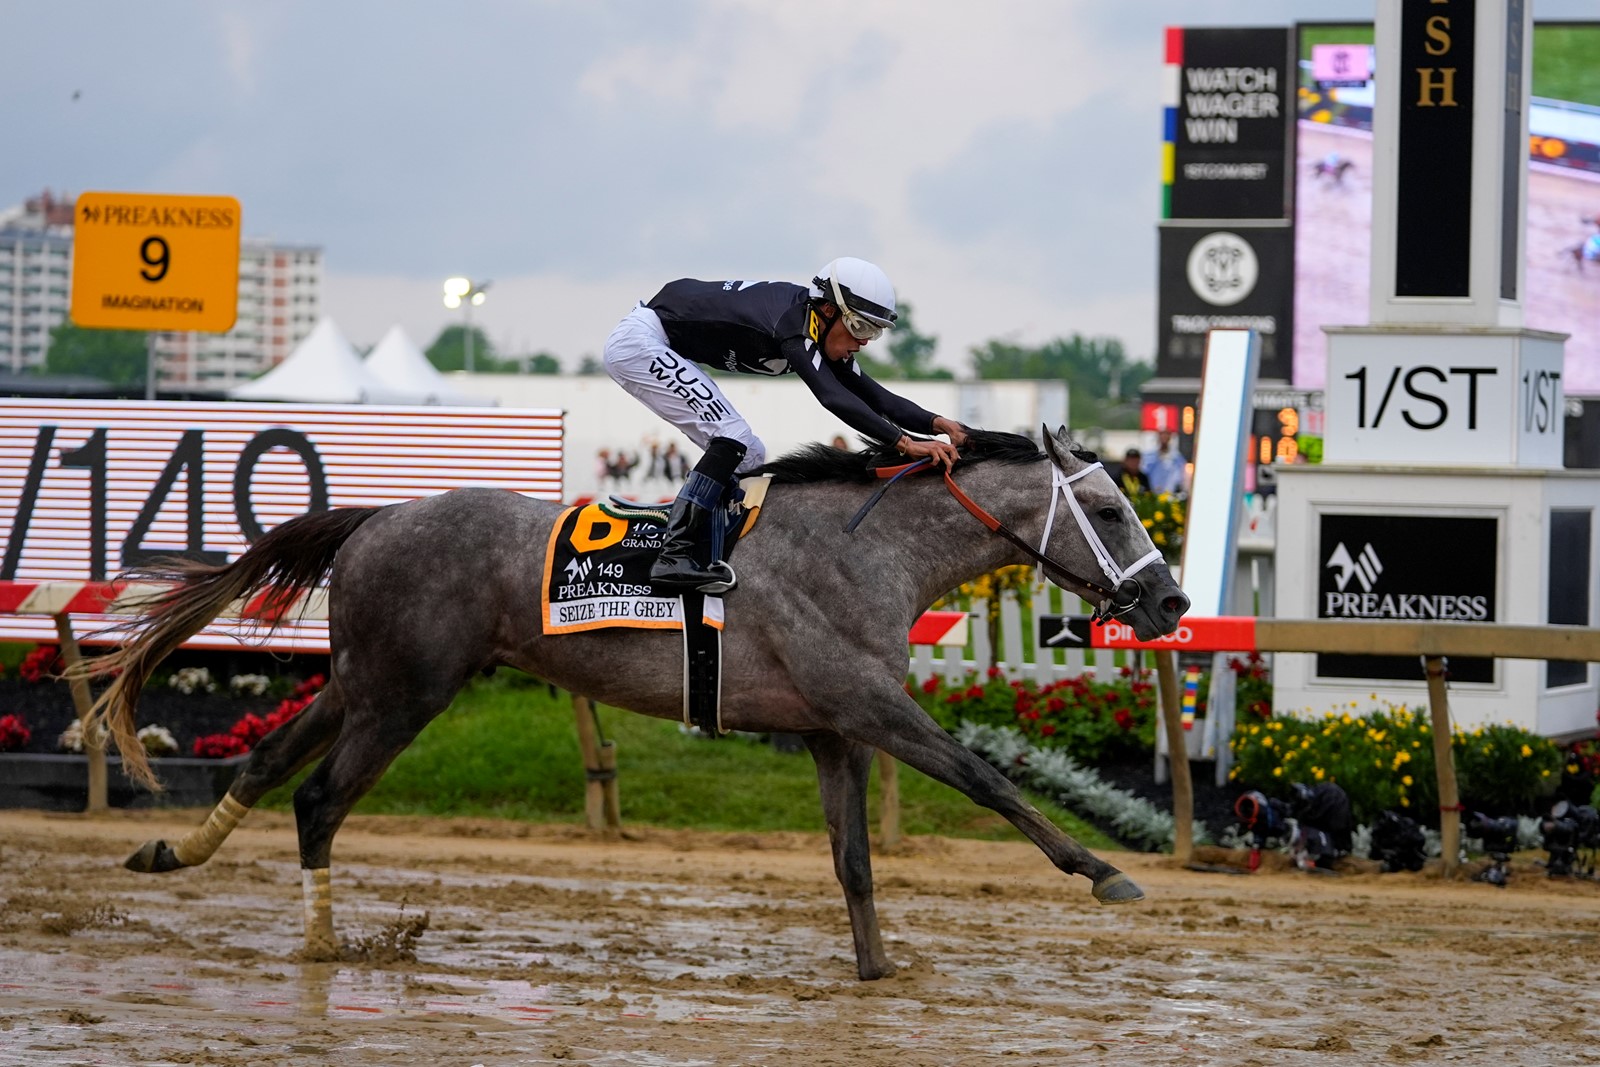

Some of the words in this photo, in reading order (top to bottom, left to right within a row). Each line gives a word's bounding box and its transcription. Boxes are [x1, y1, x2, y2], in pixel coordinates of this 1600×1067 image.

[1415, 0, 1458, 107] SH
[1186, 67, 1278, 92] WATCH
[1185, 92, 1279, 118] WAGER
[1185, 118, 1238, 143] WIN
[103, 204, 234, 231] PREAKNESS
[139, 235, 171, 283] 9
[101, 294, 204, 313] IMAGINATION
[648, 360, 716, 422] WIPES
[655, 351, 731, 422] DUDE
[1344, 365, 1498, 430] 1/ST
[1522, 369, 1561, 434] 1/ST
[621, 538, 662, 549] GRAND
[597, 562, 625, 578] 149
[557, 580, 652, 600] PREAKNESS
[559, 603, 596, 623] SEIZE
[598, 600, 630, 618] THE
[634, 600, 676, 618] GREY
[1325, 591, 1488, 621] PREAKNESS
